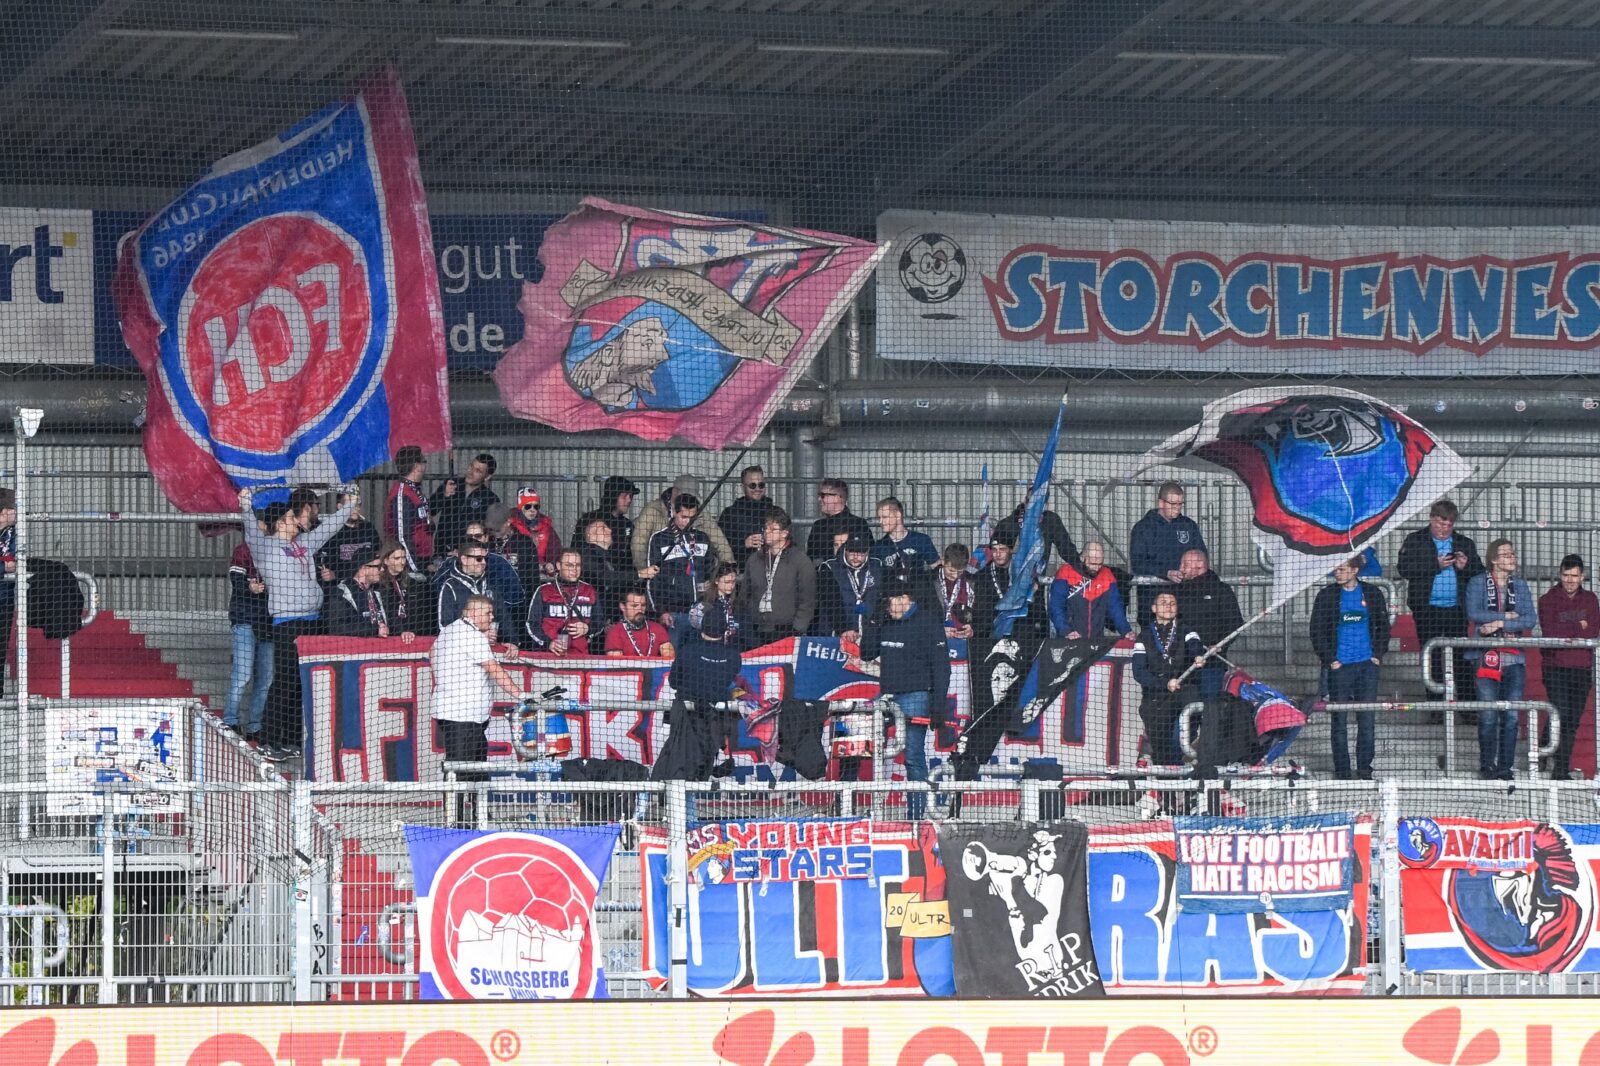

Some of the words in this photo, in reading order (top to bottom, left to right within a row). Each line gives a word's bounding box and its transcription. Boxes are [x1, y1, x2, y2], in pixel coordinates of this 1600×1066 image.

[441, 236, 525, 294] gut
[449, 312, 505, 353] de
[727, 820, 872, 850] YOUNG
[1405, 818, 1440, 840] AVANTI
[1443, 828, 1534, 860] AVANTI
[732, 845, 874, 881] STARS
[1179, 834, 1232, 864] LOVE
[1235, 831, 1350, 864] FOOTBALL
[1190, 864, 1243, 892] HATE
[1246, 861, 1342, 892] RACISM
[888, 905, 903, 917] 20
[469, 967, 570, 988] SCHLOSSBERG
[507, 988, 541, 999] UNION
